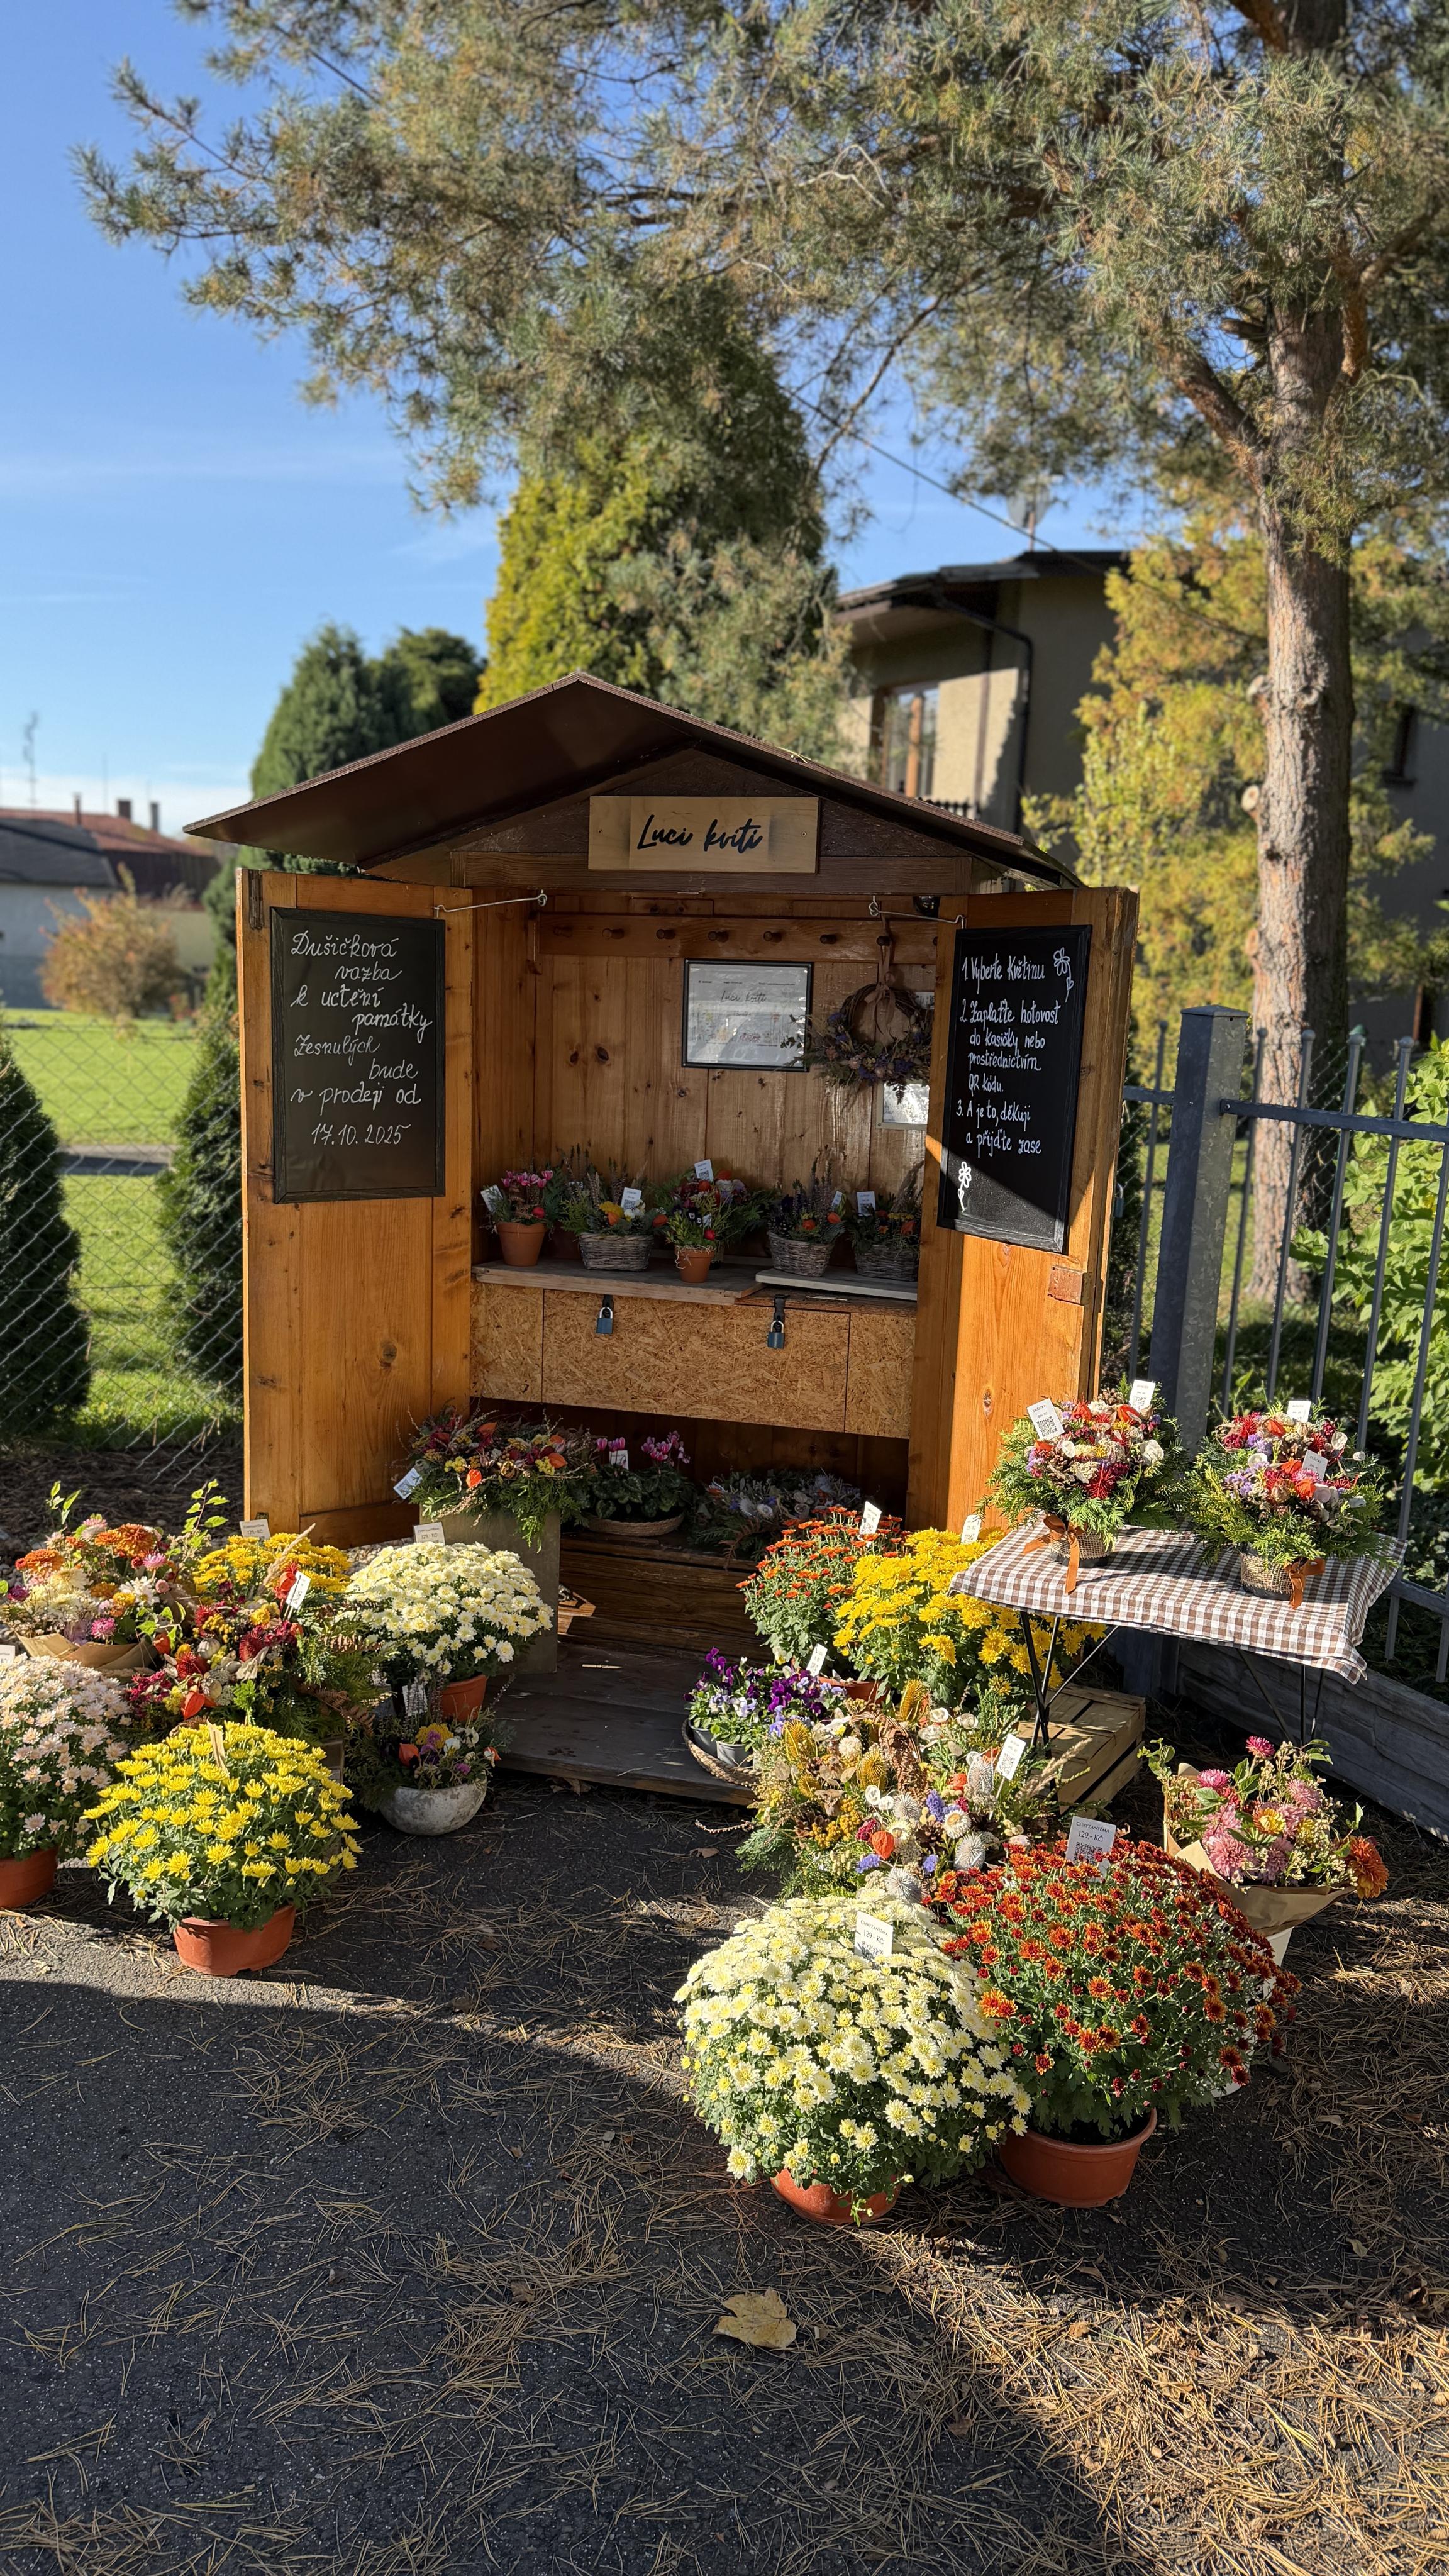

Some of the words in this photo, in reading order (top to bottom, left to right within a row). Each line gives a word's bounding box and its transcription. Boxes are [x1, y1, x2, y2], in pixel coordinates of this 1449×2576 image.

[637, 814, 694, 850] Luci
[291, 930, 399, 958] Dušičková
[335, 961, 402, 982] vazba
[970, 953, 1003, 994] Vyberte
[290, 985, 308, 1007] k
[321, 984, 385, 1007] uctění
[1021, 999, 1061, 1024] hotovost
[970, 1028, 981, 1046] do
[1024, 1031, 1045, 1048] nebo
[369, 1058, 418, 1080] bude
[968, 1049, 1041, 1071] prostřednictvím
[969, 1073, 980, 1097] QR
[290, 1088, 313, 1103] v
[319, 1080, 385, 1116] prodeji
[396, 1084, 422, 1104] od
[956, 1099, 963, 1116] 3.
[967, 1100, 973, 1118] A
[976, 1103, 984, 1129] je
[966, 1132, 973, 1143] a
[976, 1128, 1012, 1158] přijďte
[1018, 1138, 1041, 1154] zase
